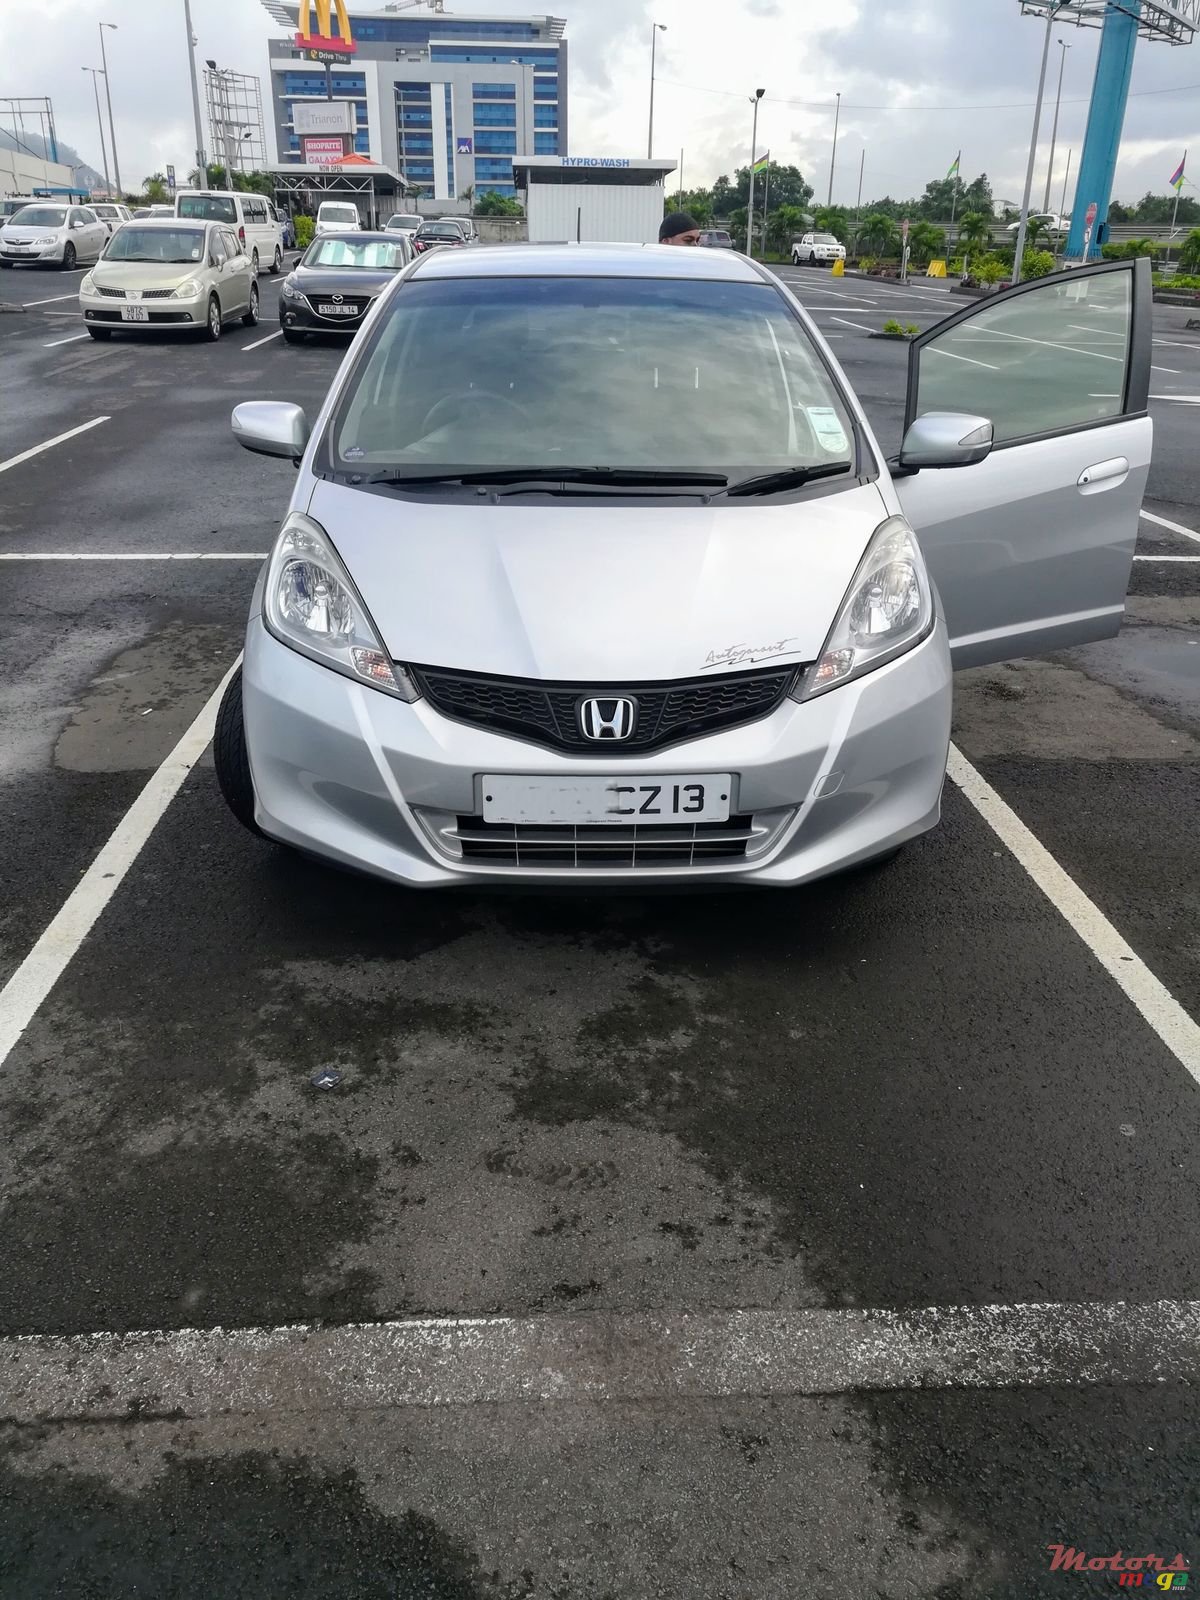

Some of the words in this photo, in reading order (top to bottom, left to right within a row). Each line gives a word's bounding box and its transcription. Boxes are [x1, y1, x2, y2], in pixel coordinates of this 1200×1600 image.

[318, 51, 335, 60] Drive
[335, 53, 347, 61] Thru
[310, 114, 343, 125] Trianon
[306, 142, 341, 150] SHOPRITE
[562, 157, 630, 168] HYPRO-WASH
[320, 305, 337, 313] 5150
[671, 784, 705, 813] 13
